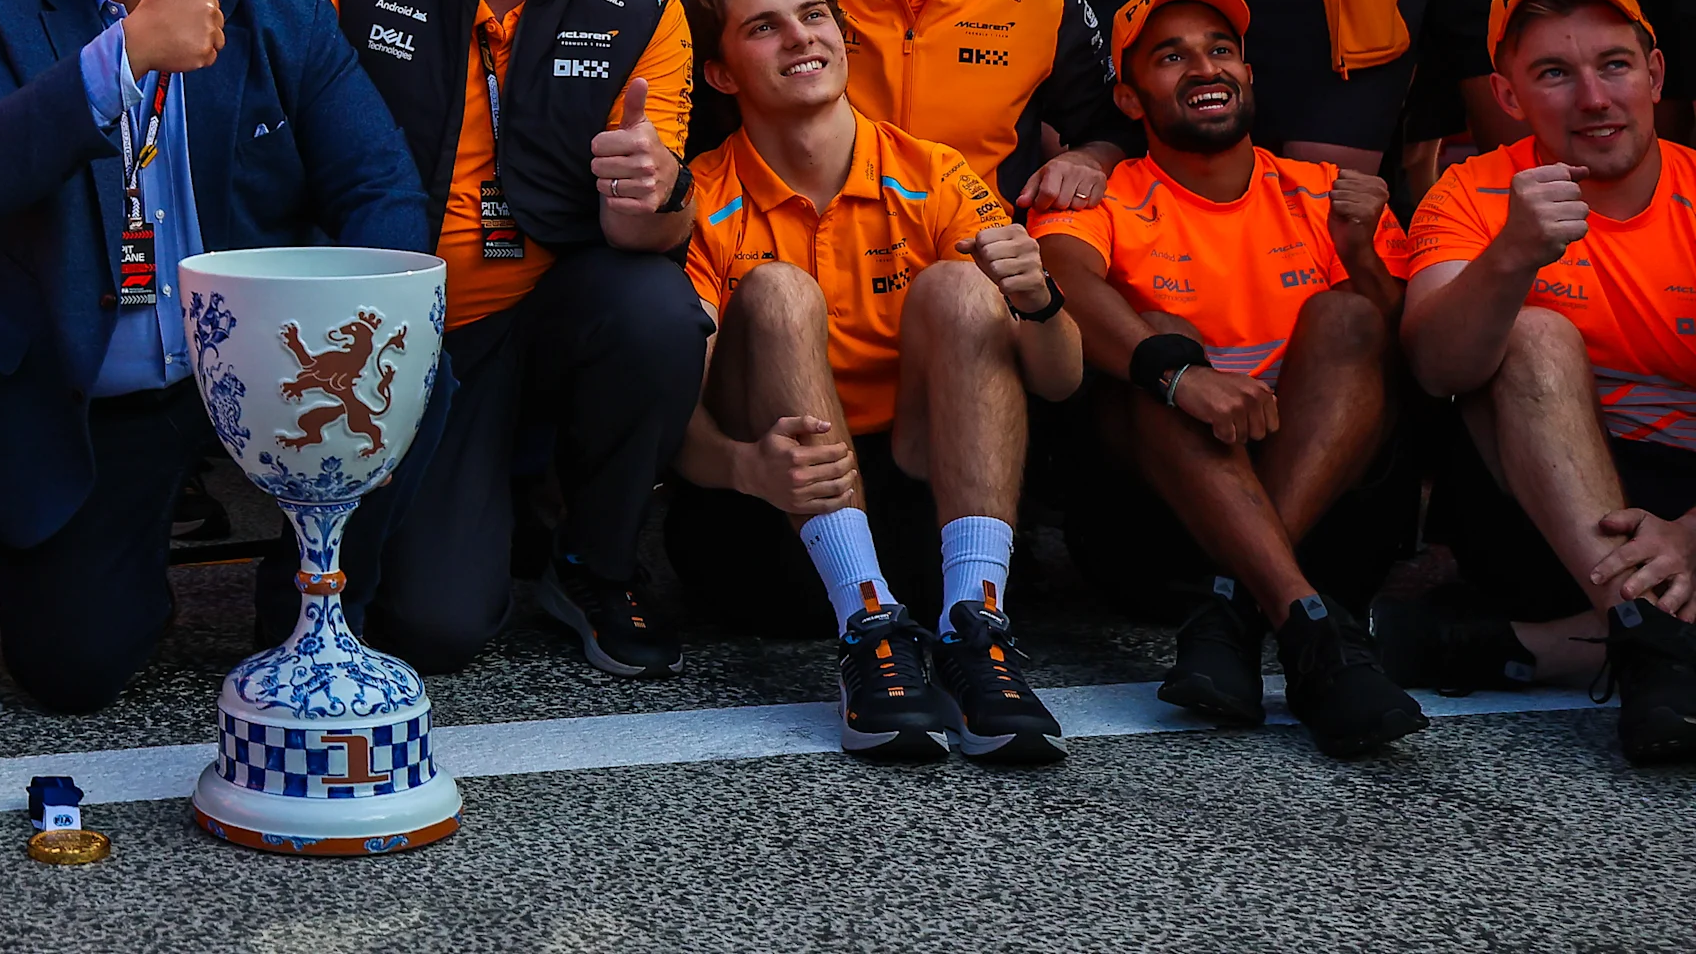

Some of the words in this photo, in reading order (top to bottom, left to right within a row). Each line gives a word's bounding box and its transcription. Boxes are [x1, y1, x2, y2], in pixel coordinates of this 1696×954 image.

[954, 21, 1016, 31] McLaren
[369, 24, 415, 51] DELL
[557, 30, 619, 41] McLaren
[367, 40, 413, 61] Technologies
[958, 48, 1009, 66] OKX
[553, 59, 609, 78] OKX
[481, 202, 509, 210] PITLA
[734, 251, 759, 261] ndroid
[871, 267, 910, 294] OKX
[1153, 275, 1195, 292] DELL
[1534, 278, 1589, 300] DELL
[320, 735, 389, 785] 1
[54, 816, 71, 824] FIA
